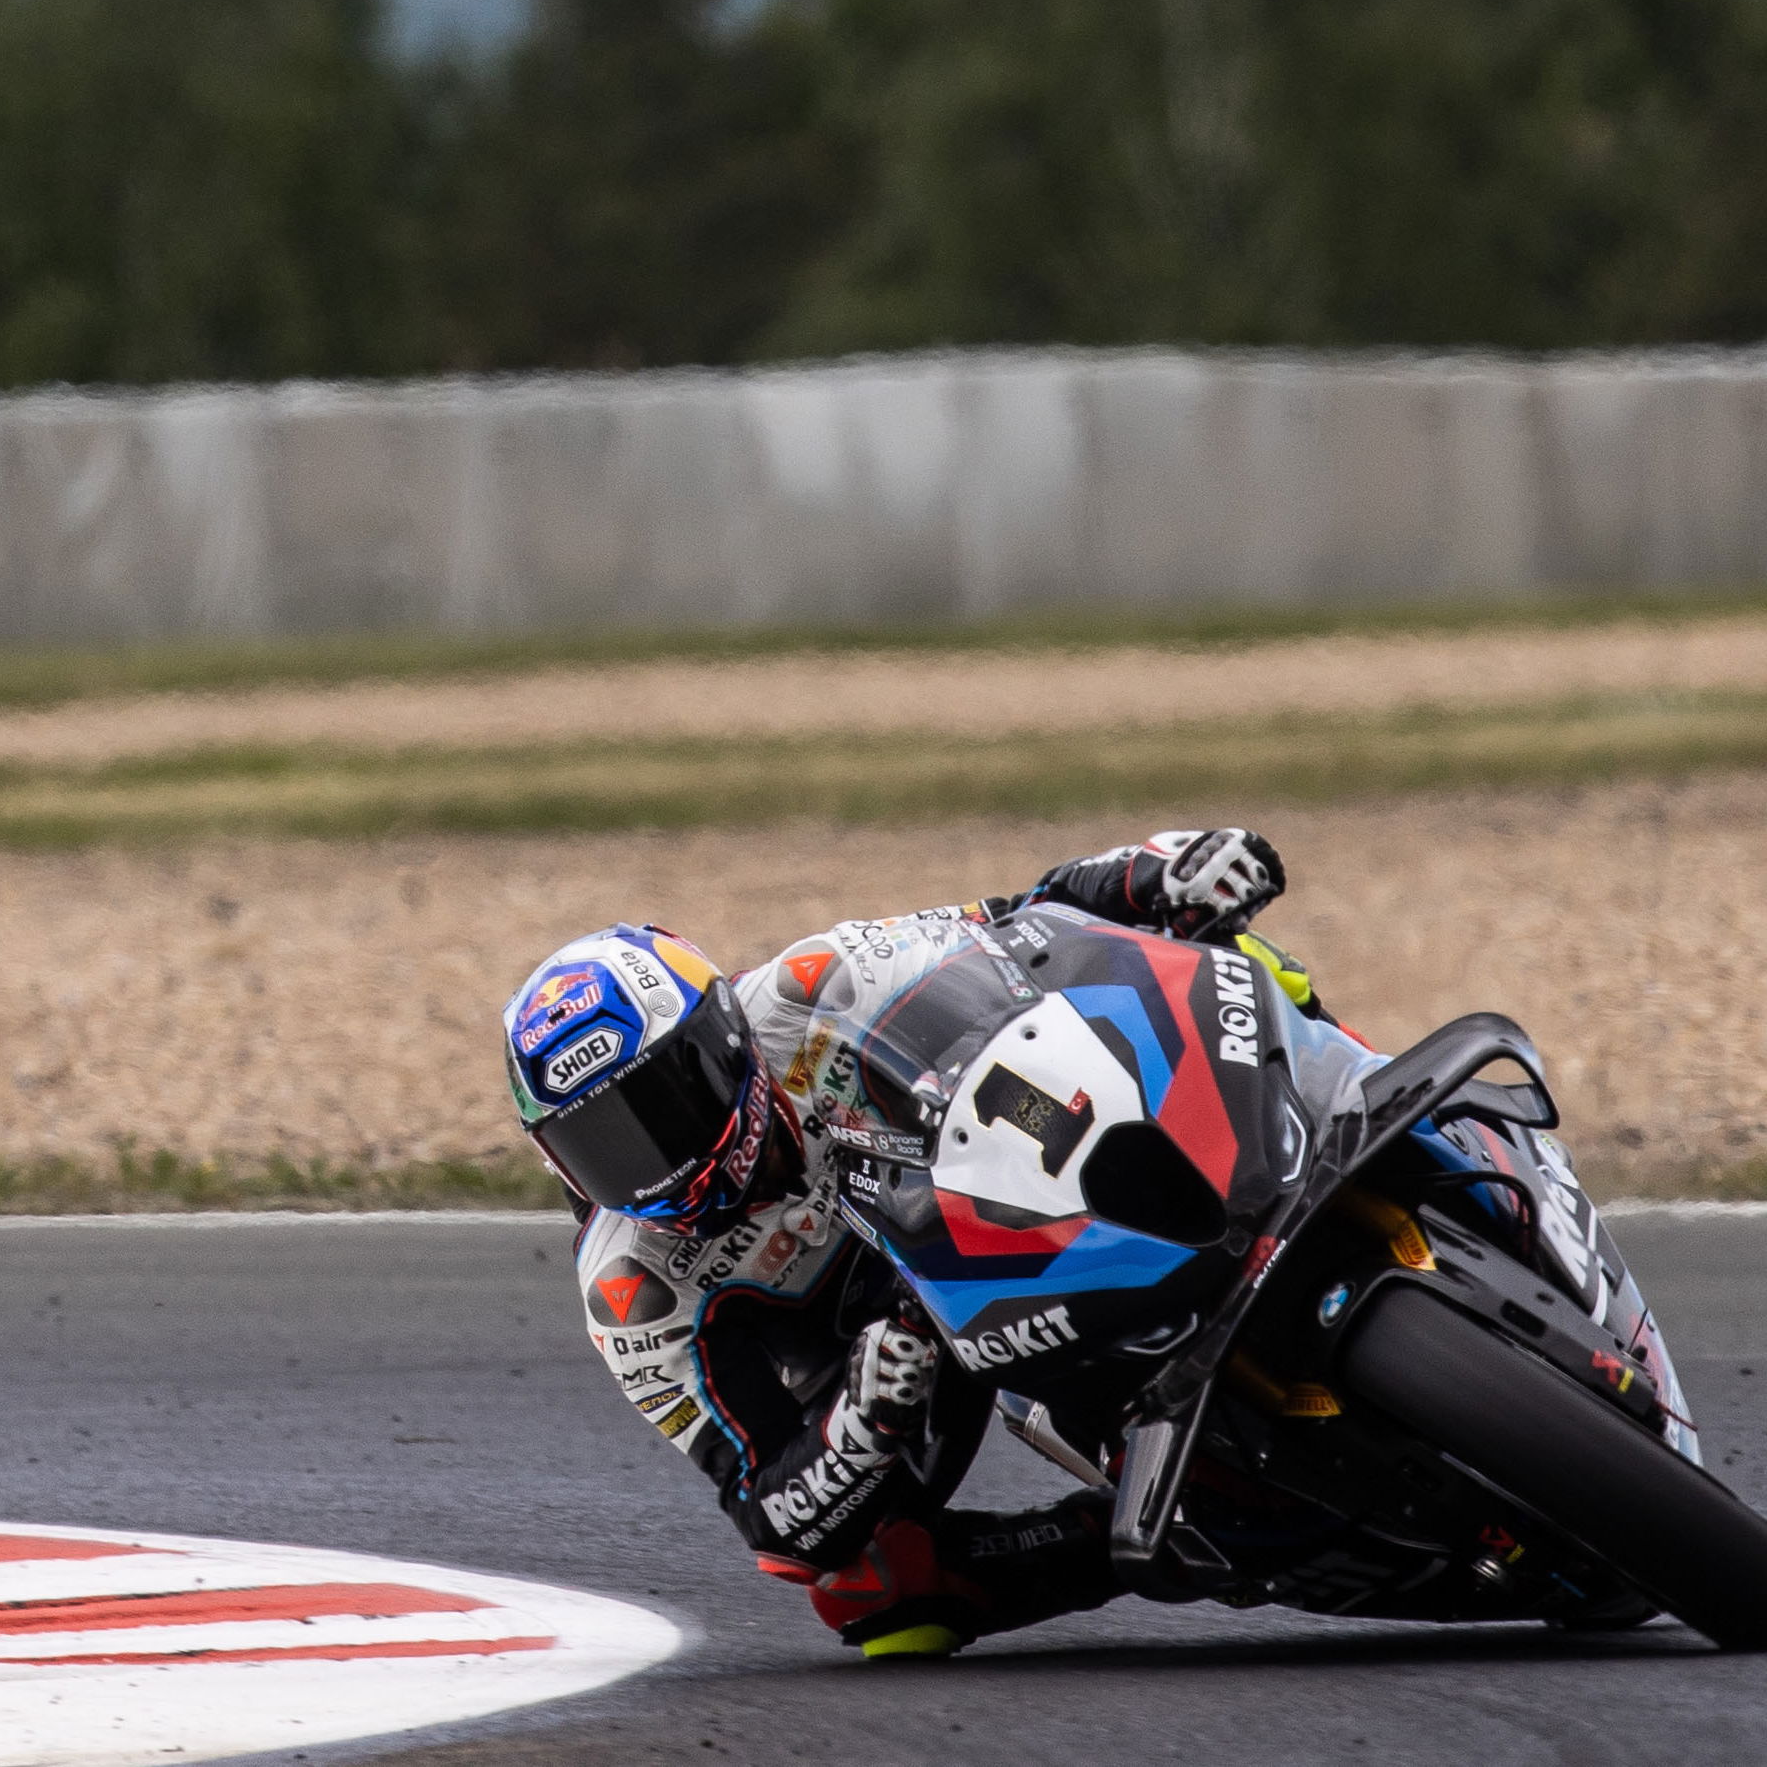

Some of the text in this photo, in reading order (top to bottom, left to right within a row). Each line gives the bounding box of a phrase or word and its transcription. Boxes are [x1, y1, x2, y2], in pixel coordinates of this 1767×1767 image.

[621, 951, 660, 990] Beta
[1211, 948, 1259, 1068] ROKiT
[551, 1035, 611, 1085] SHOEI
[557, 1052, 651, 1118] GIVES YOU WINGS
[972, 1060, 1096, 1181] 1
[849, 1171, 881, 1194] EDOX
[671, 1239, 703, 1275] SHO
[953, 1305, 1080, 1372] ROKiT
[760, 1449, 866, 1537] ROKi
[819, 1469, 890, 1531] MOTORRA
